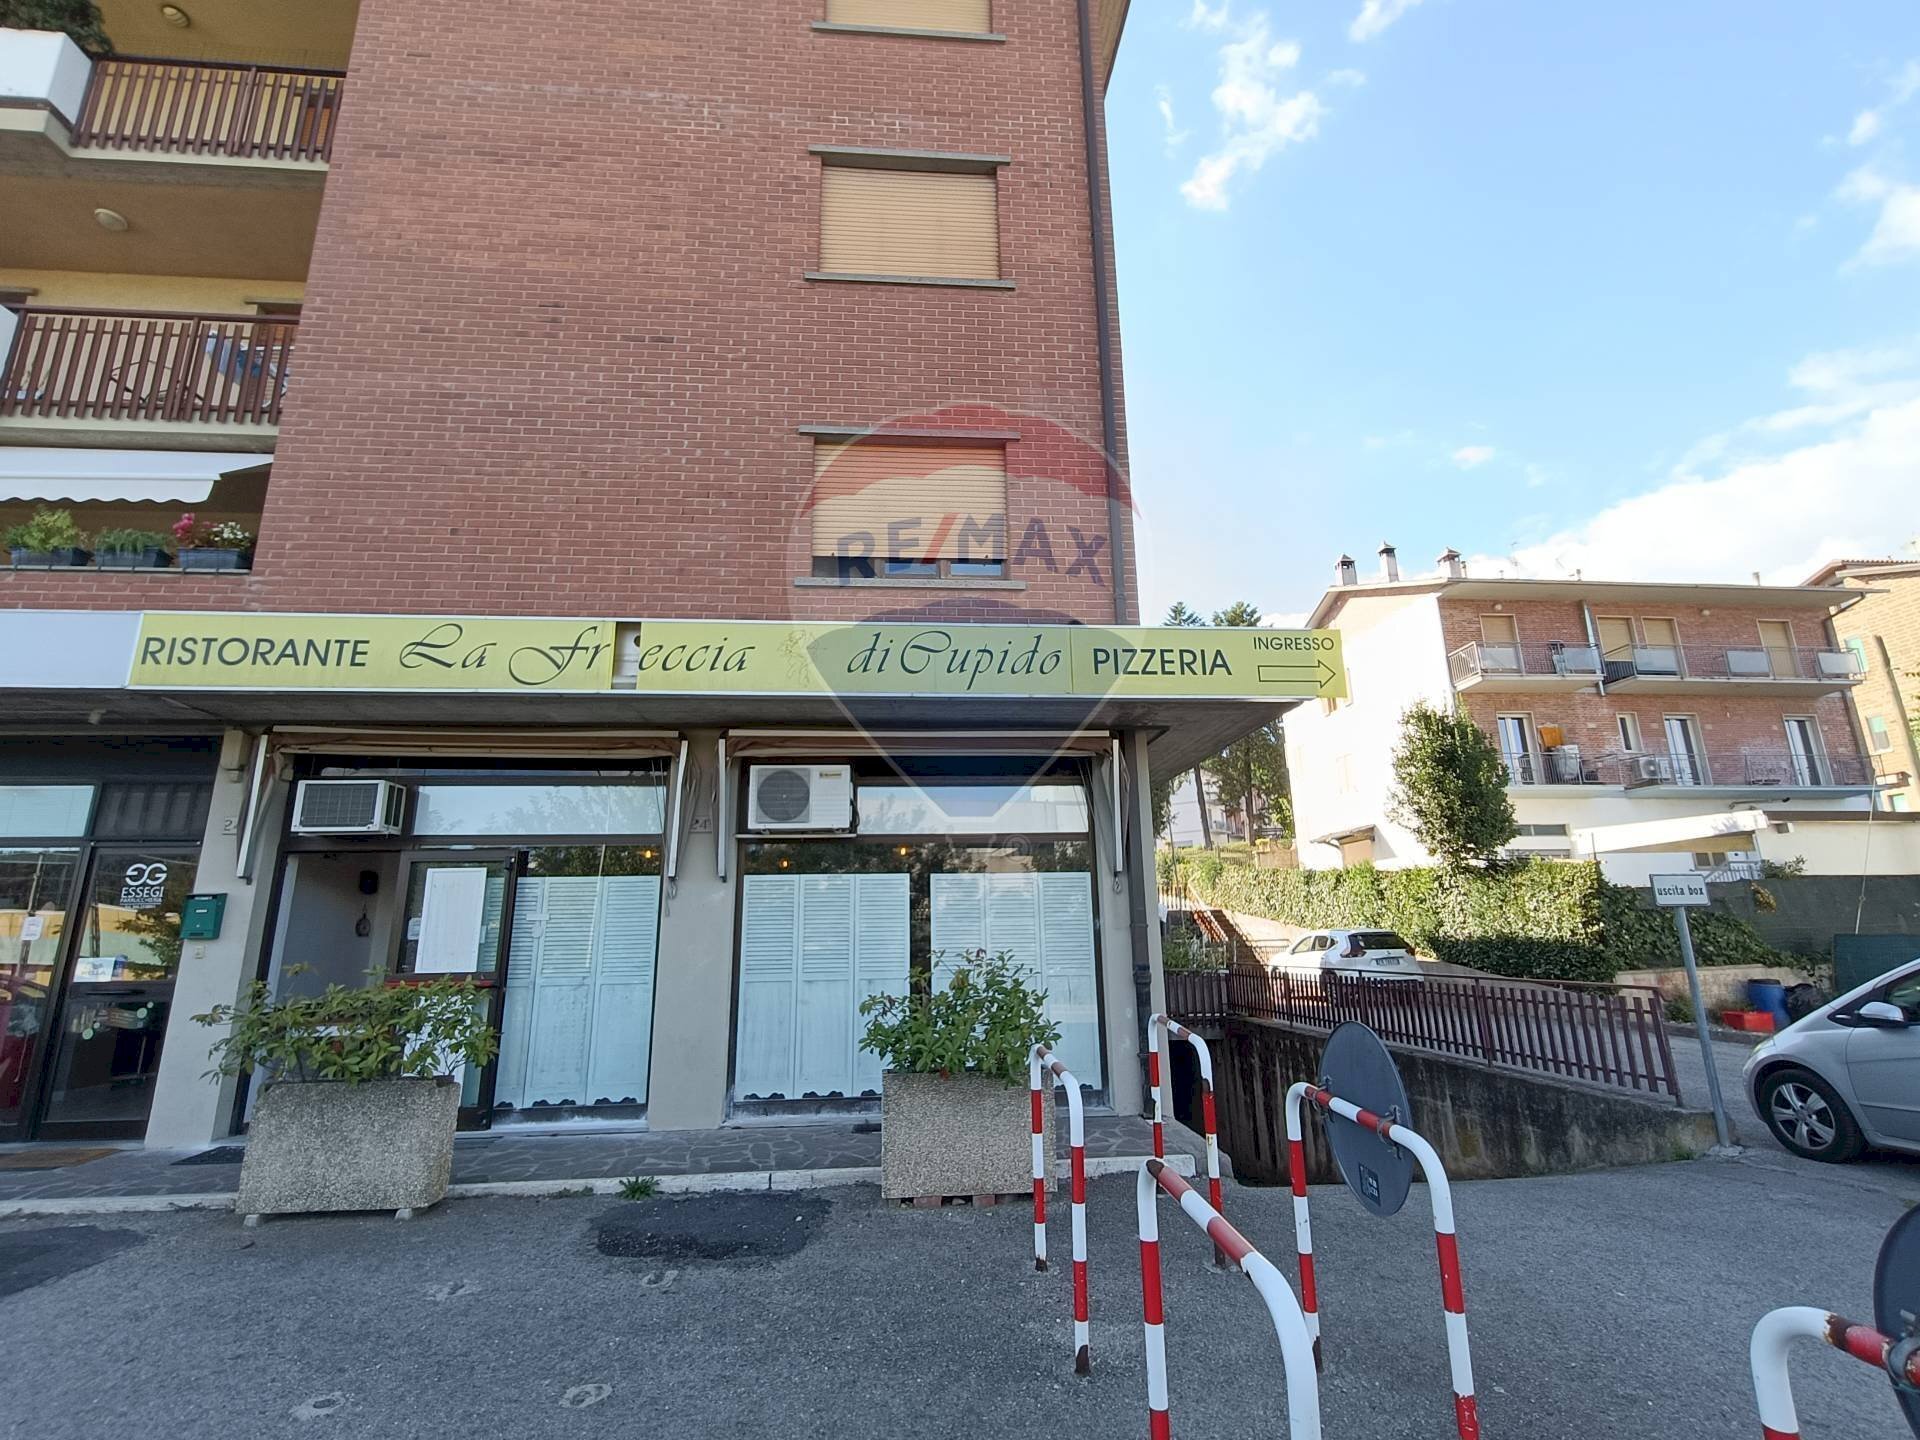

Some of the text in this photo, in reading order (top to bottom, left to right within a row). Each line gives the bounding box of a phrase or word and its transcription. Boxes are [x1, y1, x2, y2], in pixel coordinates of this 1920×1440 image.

[1253, 636, 1335, 651] INGRESSO
[140, 637, 370, 667] RISTORANTE
[400, 623, 497, 669] La
[847, 631, 895, 674] di
[900, 630, 1062, 691] Cupido
[1093, 648, 1232, 676] PIZZERIA
[121, 886, 164, 898] ESSEGI
[1657, 884, 1704, 896] uscita box
